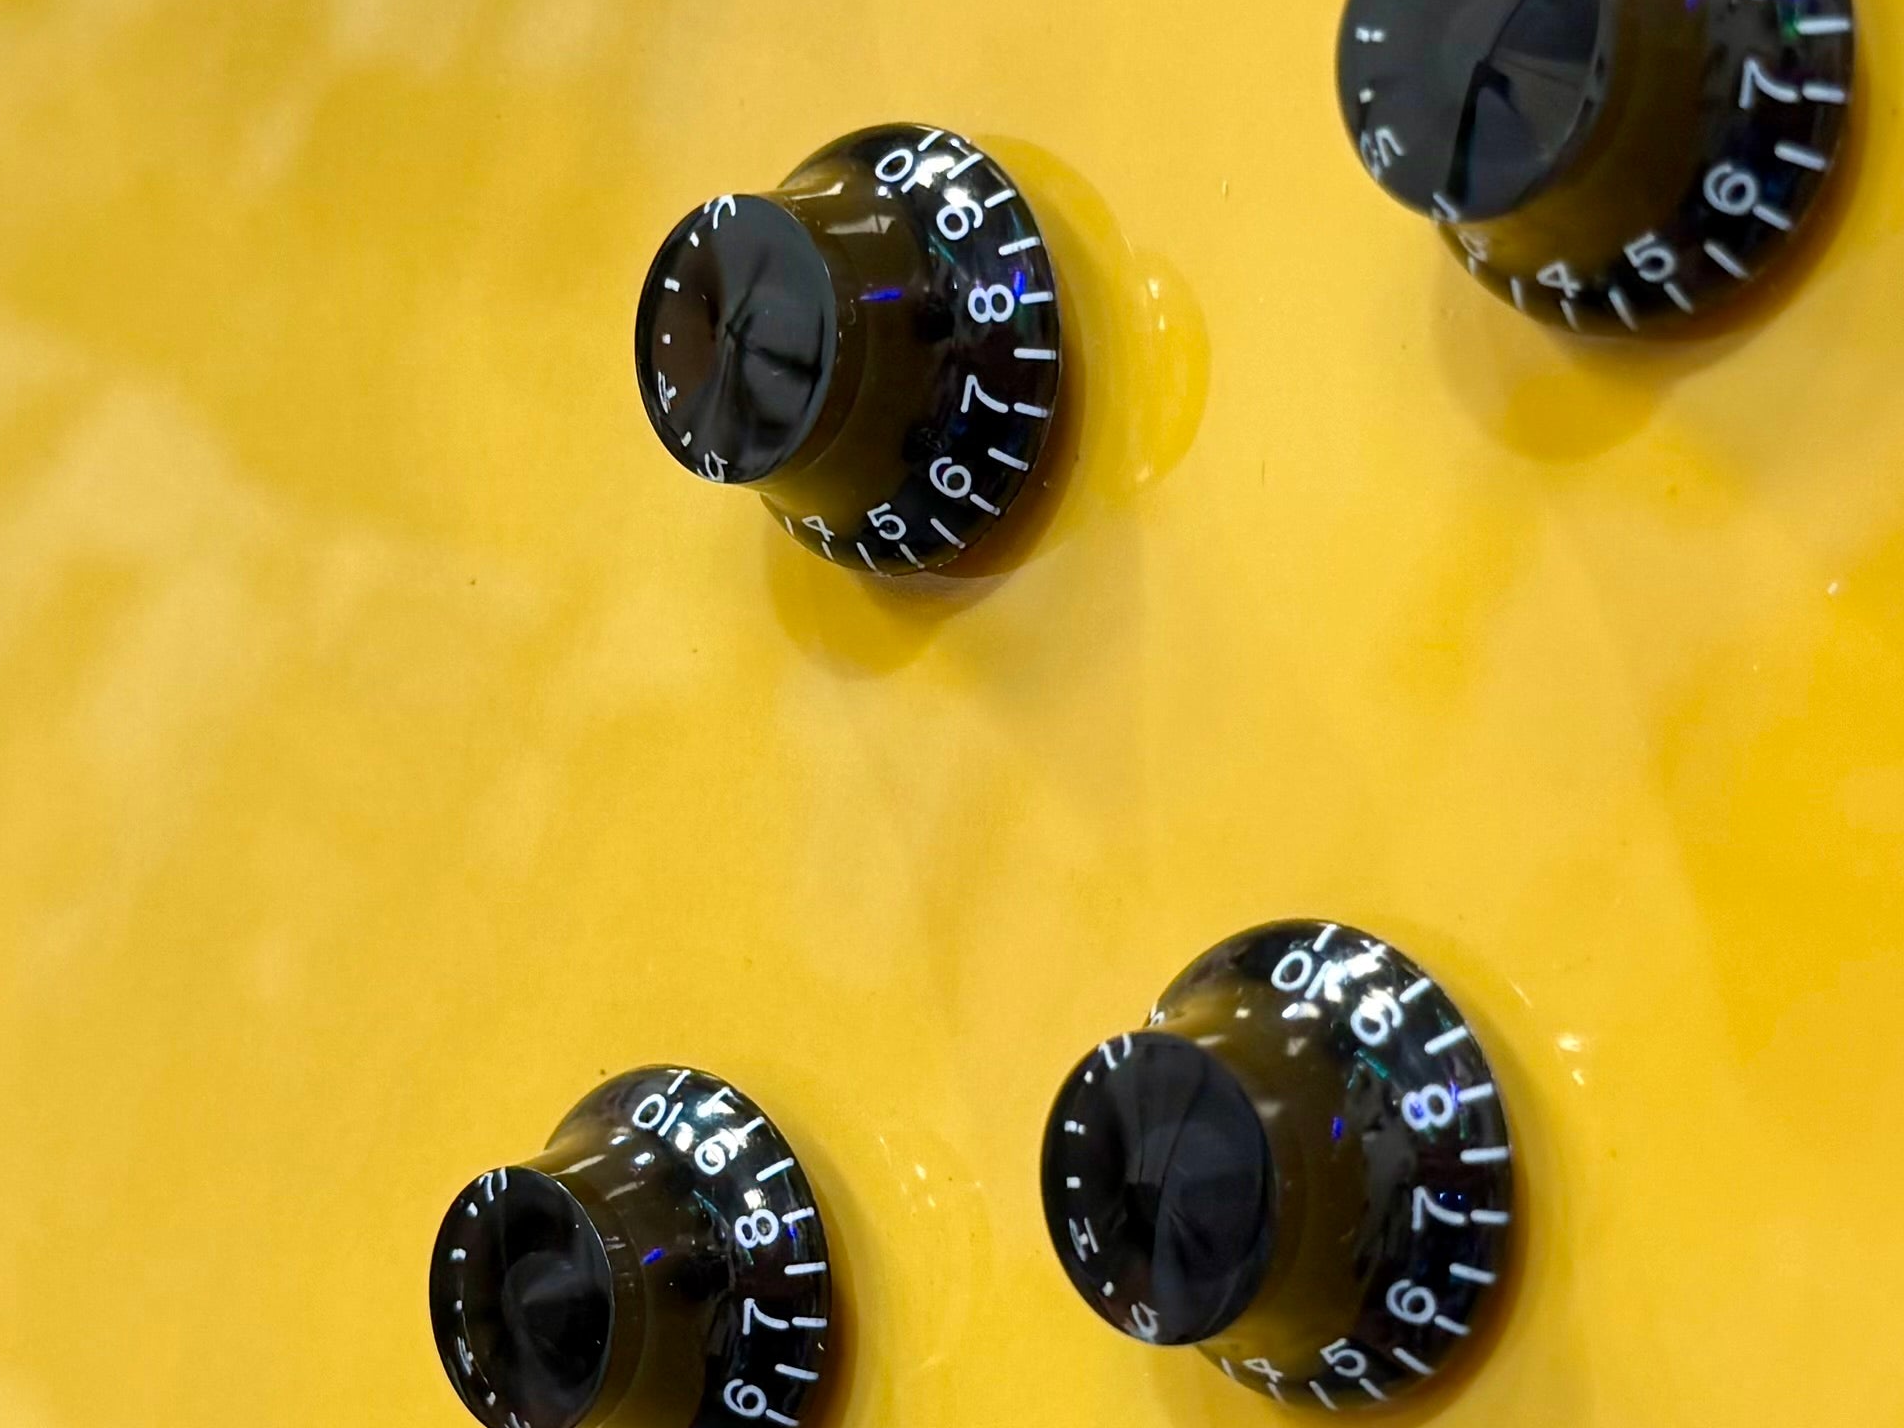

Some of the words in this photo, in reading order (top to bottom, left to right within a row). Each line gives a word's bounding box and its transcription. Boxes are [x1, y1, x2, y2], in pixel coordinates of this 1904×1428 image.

[1740, 60, 1799, 108] 7
[874, 149, 927, 193] 10
[1704, 164, 1756, 215] 6
[936, 194, 984, 241] 9
[1624, 231, 1676, 281] 5
[1536, 261, 1581, 299] 4
[968, 284, 1015, 323] 8
[961, 375, 1008, 414] 7
[929, 457, 972, 498] 6
[802, 516, 835, 542] 4
[867, 503, 906, 541] 5
[1271, 950, 1332, 999] 10
[1350, 997, 1403, 1046] 9
[632, 1093, 683, 1136] 10
[1401, 1084, 1454, 1130] 8
[695, 1129, 738, 1175] 9
[735, 1208, 780, 1249] 8
[1412, 1186, 1466, 1232] 7
[743, 1298, 789, 1335] 7
[1386, 1279, 1437, 1324] 6
[1243, 1357, 1283, 1381] 4
[1320, 1337, 1367, 1378] 5
[723, 1378, 767, 1417] 6
